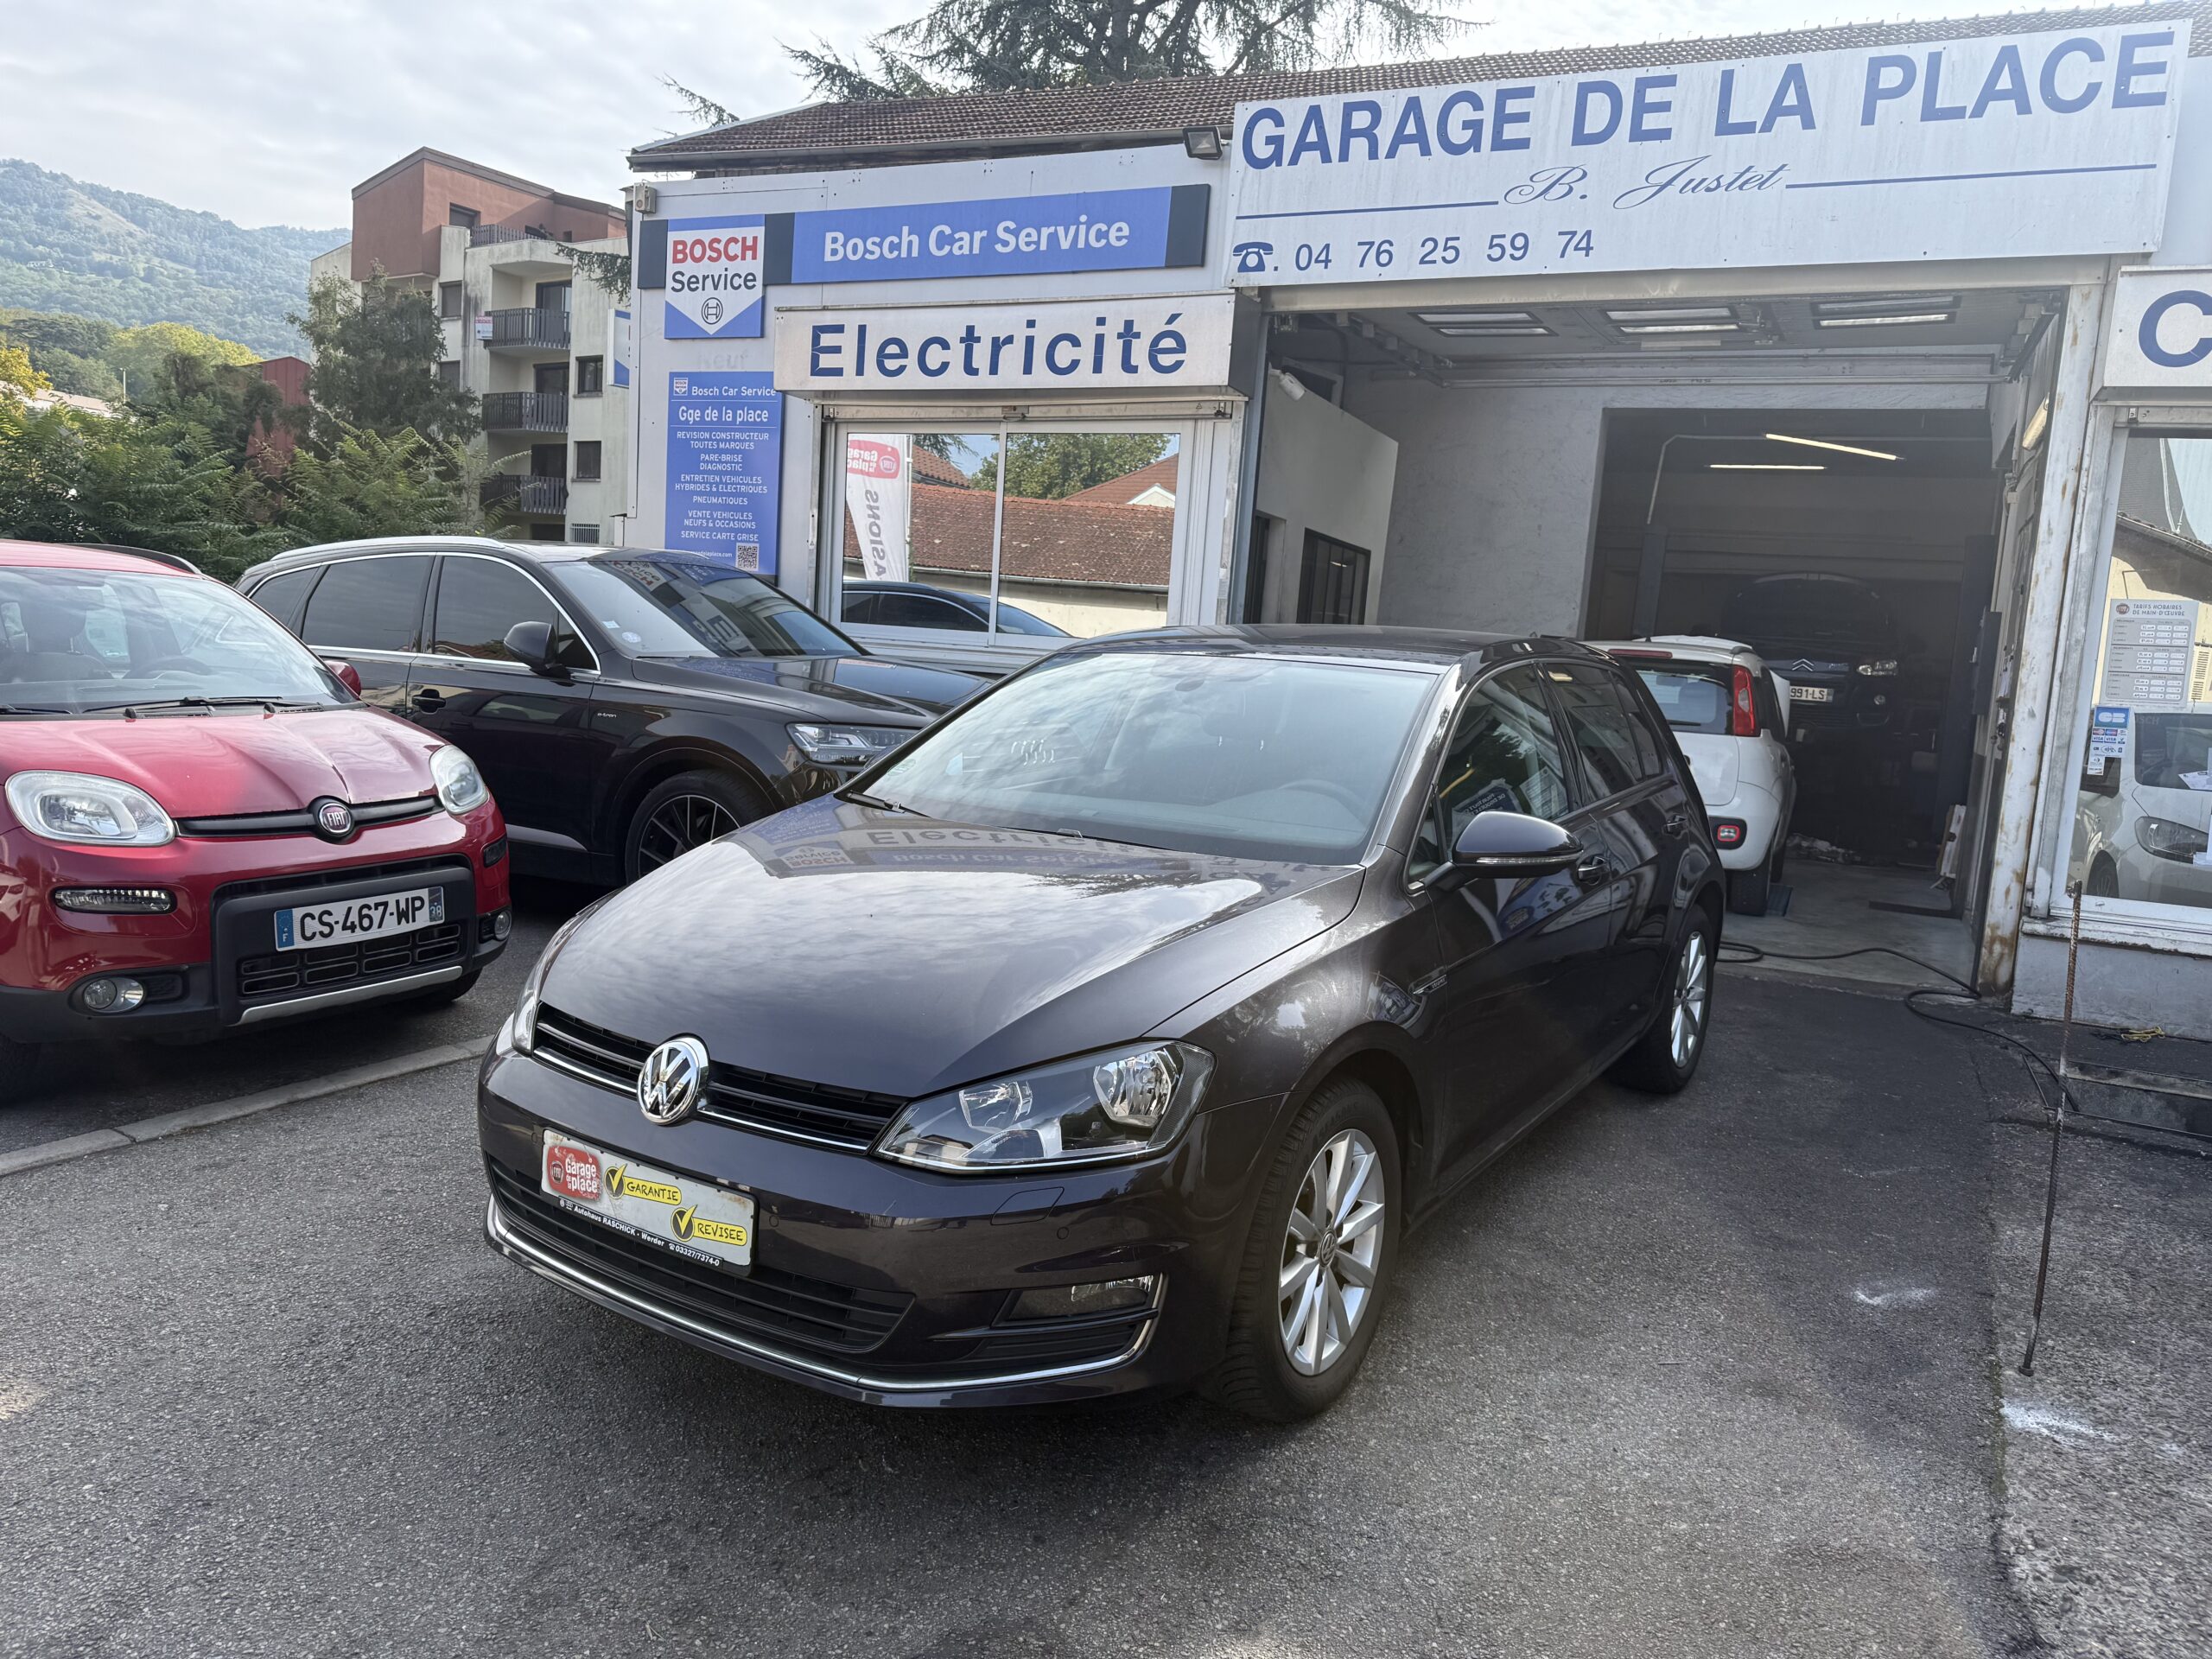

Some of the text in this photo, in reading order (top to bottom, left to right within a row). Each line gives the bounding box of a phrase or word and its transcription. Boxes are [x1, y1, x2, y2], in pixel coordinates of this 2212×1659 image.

[1242, 30, 2175, 169] GARAGE DE LA PLACE
[1504, 155, 1790, 210] B. Justet
[823, 214, 1130, 262] Bosch Car Service
[671, 235, 759, 264] BOSCH
[1294, 230, 1594, 271] 04 76 25 59 74
[671, 267, 758, 293] Service
[810, 312, 1186, 378] Electricité
[691, 385, 777, 397] Bosch Car Service
[678, 405, 769, 425] Gge de la place
[711, 432, 769, 441] CONSTRUCTEUR
[700, 454, 742, 462] PARE-BRISE
[681, 474, 762, 484] ENTRETIEN VEHICULES
[675, 483, 710, 492] HYBRIDES
[719, 485, 768, 493] ELECTRIQUES
[692, 496, 748, 505] PNEUMATIQUES
[688, 510, 753, 520] VENTE VEHICULES
[715, 520, 756, 529] OCCASIONS
[681, 531, 710, 539] SERVICE
[737, 533, 759, 542] GRISE
[327, 810, 345, 826] FIAT
[299, 895, 425, 942] CS-467-WP
[429, 904, 442, 918] 38
[282, 933, 288, 942] F
[565, 1158, 597, 1179] Garage
[571, 1175, 598, 1192] place
[626, 1181, 679, 1202] GARANTIE
[574, 1205, 720, 1267] Autohaus RASCHICK Werder 03327/7374-0
[697, 1224, 744, 1242] REVISEE
